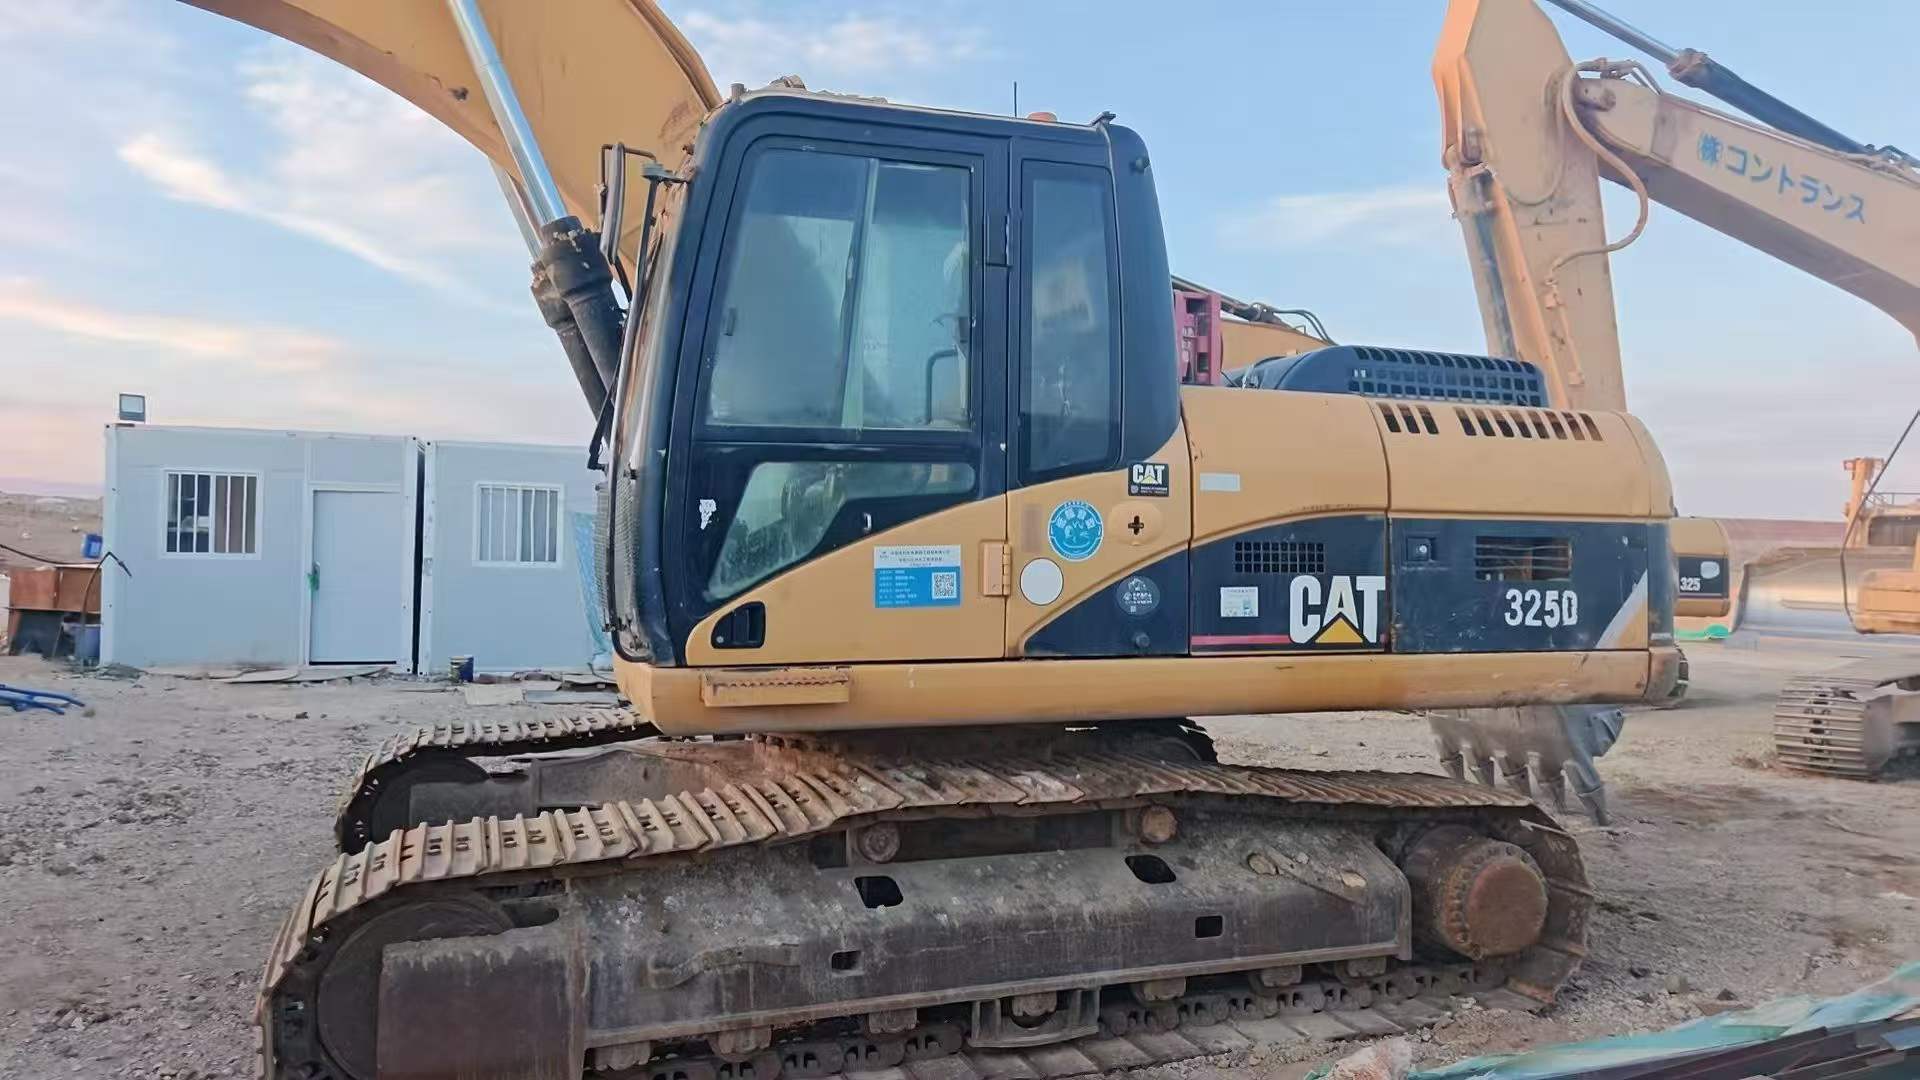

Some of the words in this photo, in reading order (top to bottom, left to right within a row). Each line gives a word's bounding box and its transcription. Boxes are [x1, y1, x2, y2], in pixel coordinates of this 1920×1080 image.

[1132, 464, 1165, 484] CAT
[1680, 577, 1701, 591] 325
[1289, 575, 1386, 644] CAT
[1504, 589, 1578, 628] 325D
